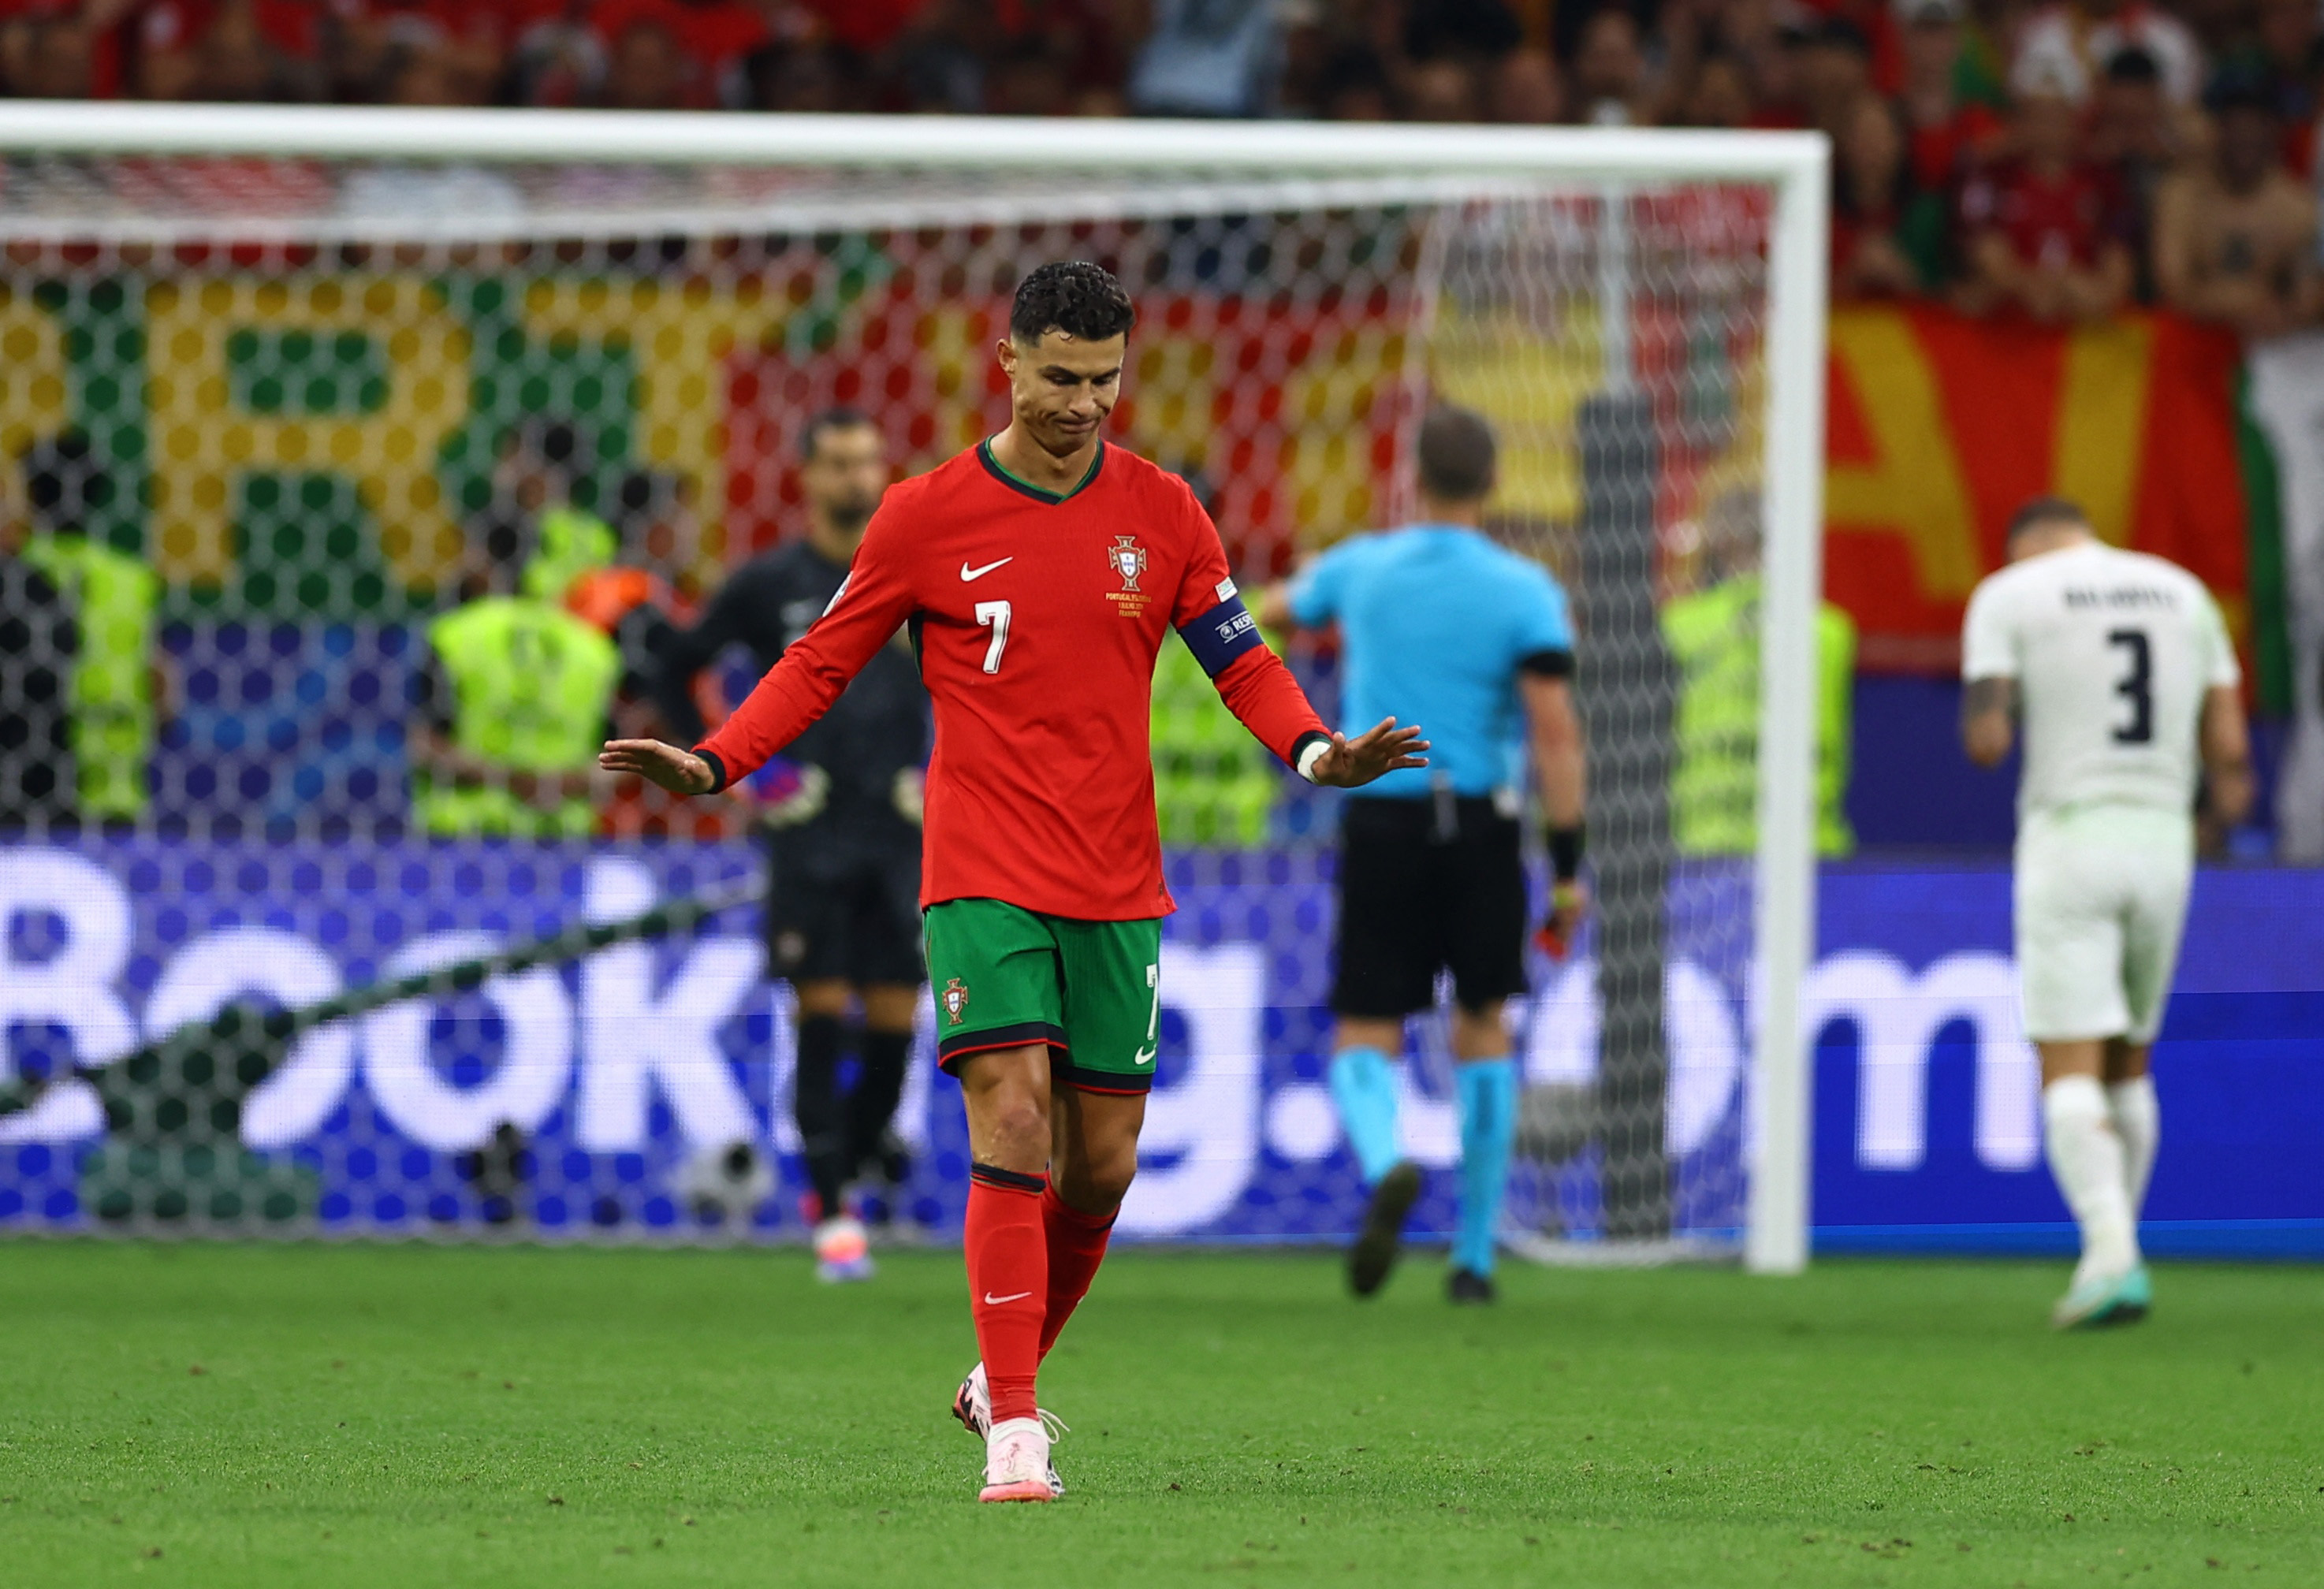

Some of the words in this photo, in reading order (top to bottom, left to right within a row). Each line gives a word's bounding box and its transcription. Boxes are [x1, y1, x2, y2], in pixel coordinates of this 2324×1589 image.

[974, 600, 1011, 674] 7
[2105, 628, 2155, 744] 3
[1146, 963, 1159, 1040] 7
